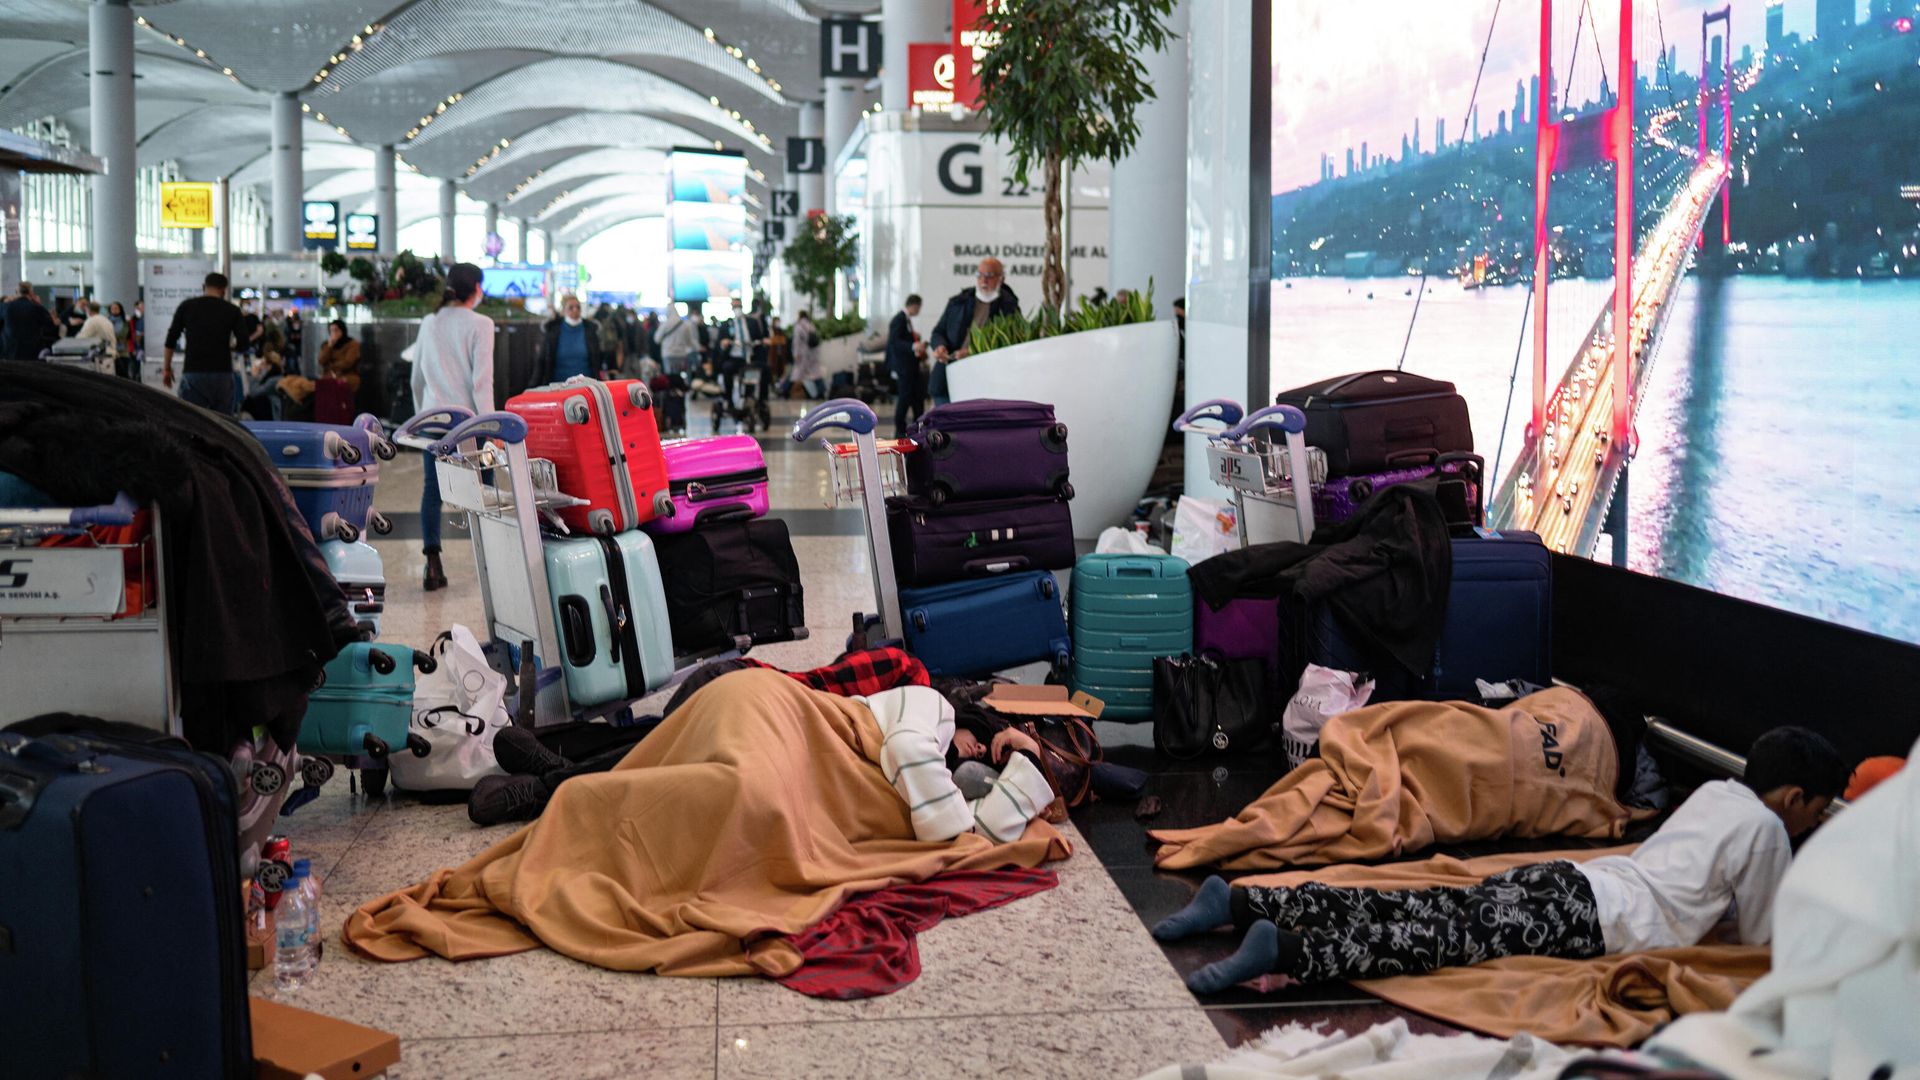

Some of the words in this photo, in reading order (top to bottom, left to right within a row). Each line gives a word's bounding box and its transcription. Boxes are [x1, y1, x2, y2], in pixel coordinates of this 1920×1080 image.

[831, 24, 869, 72] H
[797, 140, 814, 171] J
[937, 142, 984, 195] G
[775, 192, 793, 216] K
[767, 222, 780, 240] L
[953, 245, 999, 258] BAGAJ
[1538, 721, 1563, 770] FAD
